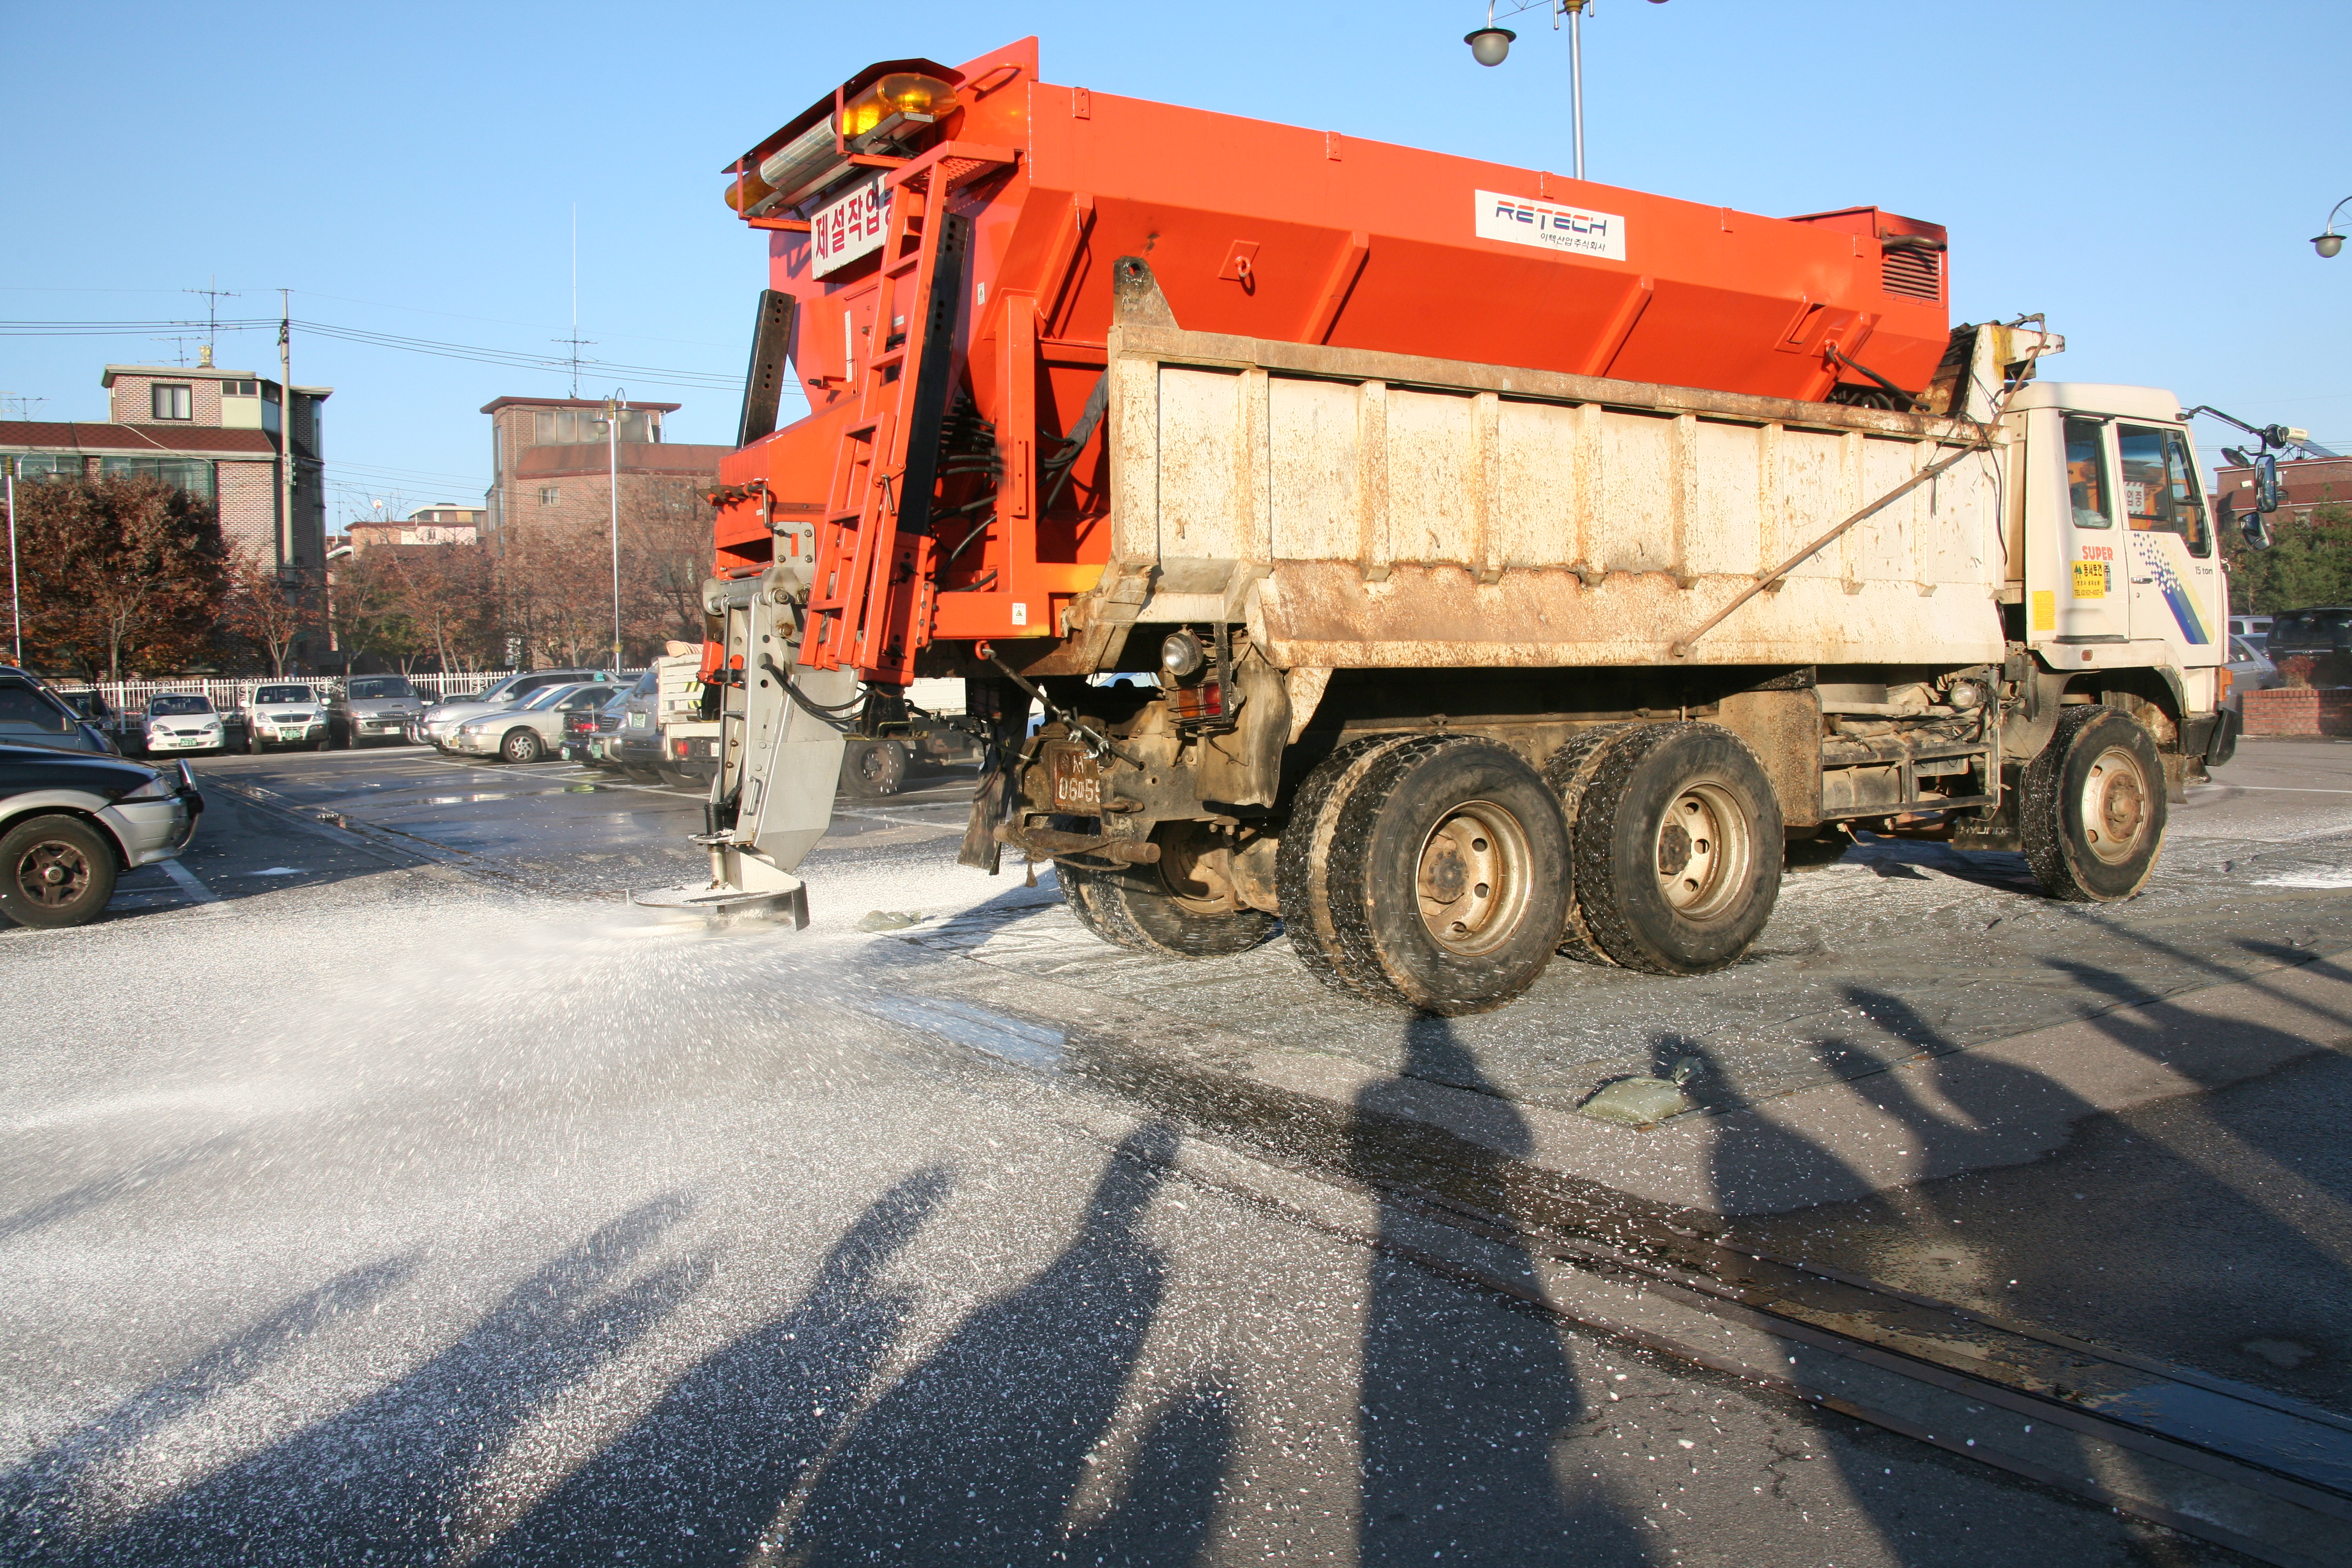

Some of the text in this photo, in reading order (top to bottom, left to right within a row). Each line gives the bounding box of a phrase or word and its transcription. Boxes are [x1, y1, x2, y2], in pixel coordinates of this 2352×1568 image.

[1495, 200, 1607, 237] RETECH
[1574, 239, 1606, 252] 주식회사
[2082, 545, 2114, 561] SUPER
[2195, 566, 2213, 575] 15 ton
